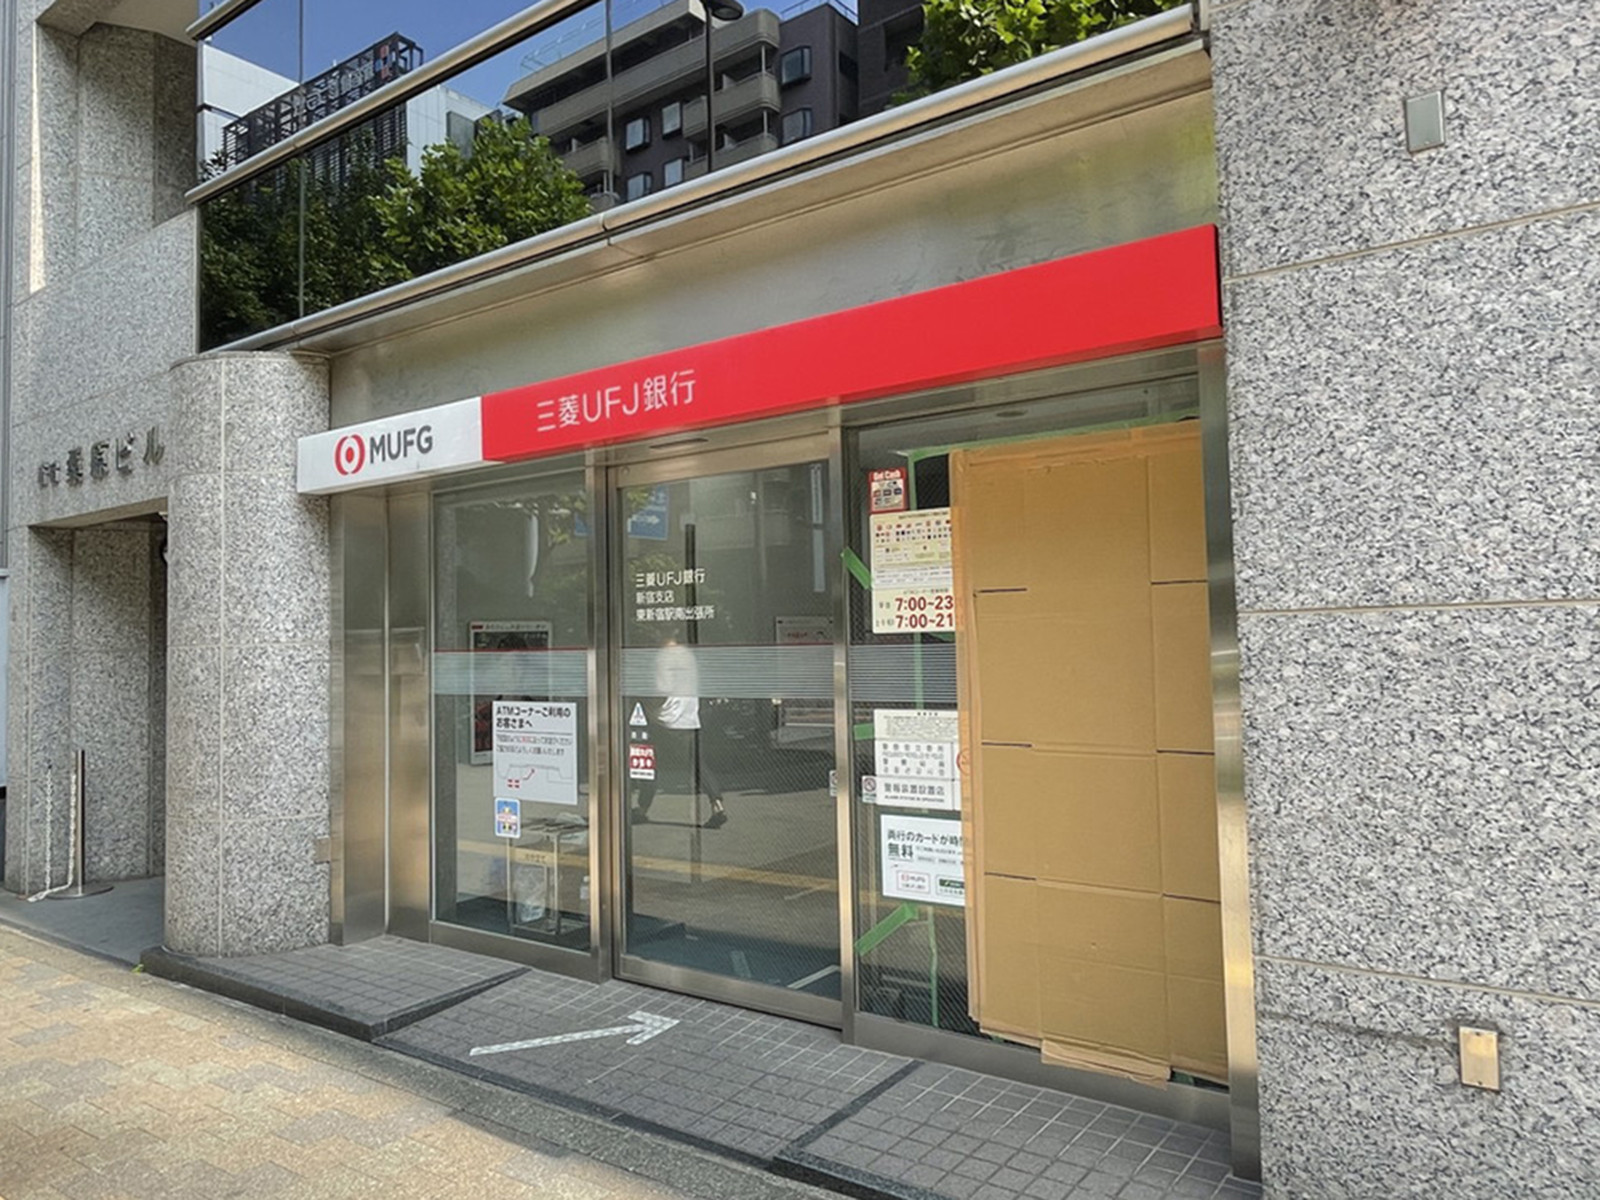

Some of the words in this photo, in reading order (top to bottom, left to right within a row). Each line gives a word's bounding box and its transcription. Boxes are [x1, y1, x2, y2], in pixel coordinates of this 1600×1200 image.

[536, 369, 696, 432] 三菱UFJ銀行
[369, 424, 433, 464] MUFG
[635, 567, 705, 588] 三菱UFJ銀行
[635, 589, 675, 604] 新宿支店
[496, 705, 571, 718] ATMコーナーご利用の
[496, 717, 533, 729] お客さまへ
[884, 782, 945, 796] 警報装置設置店
[888, 843, 913, 858] 無料
